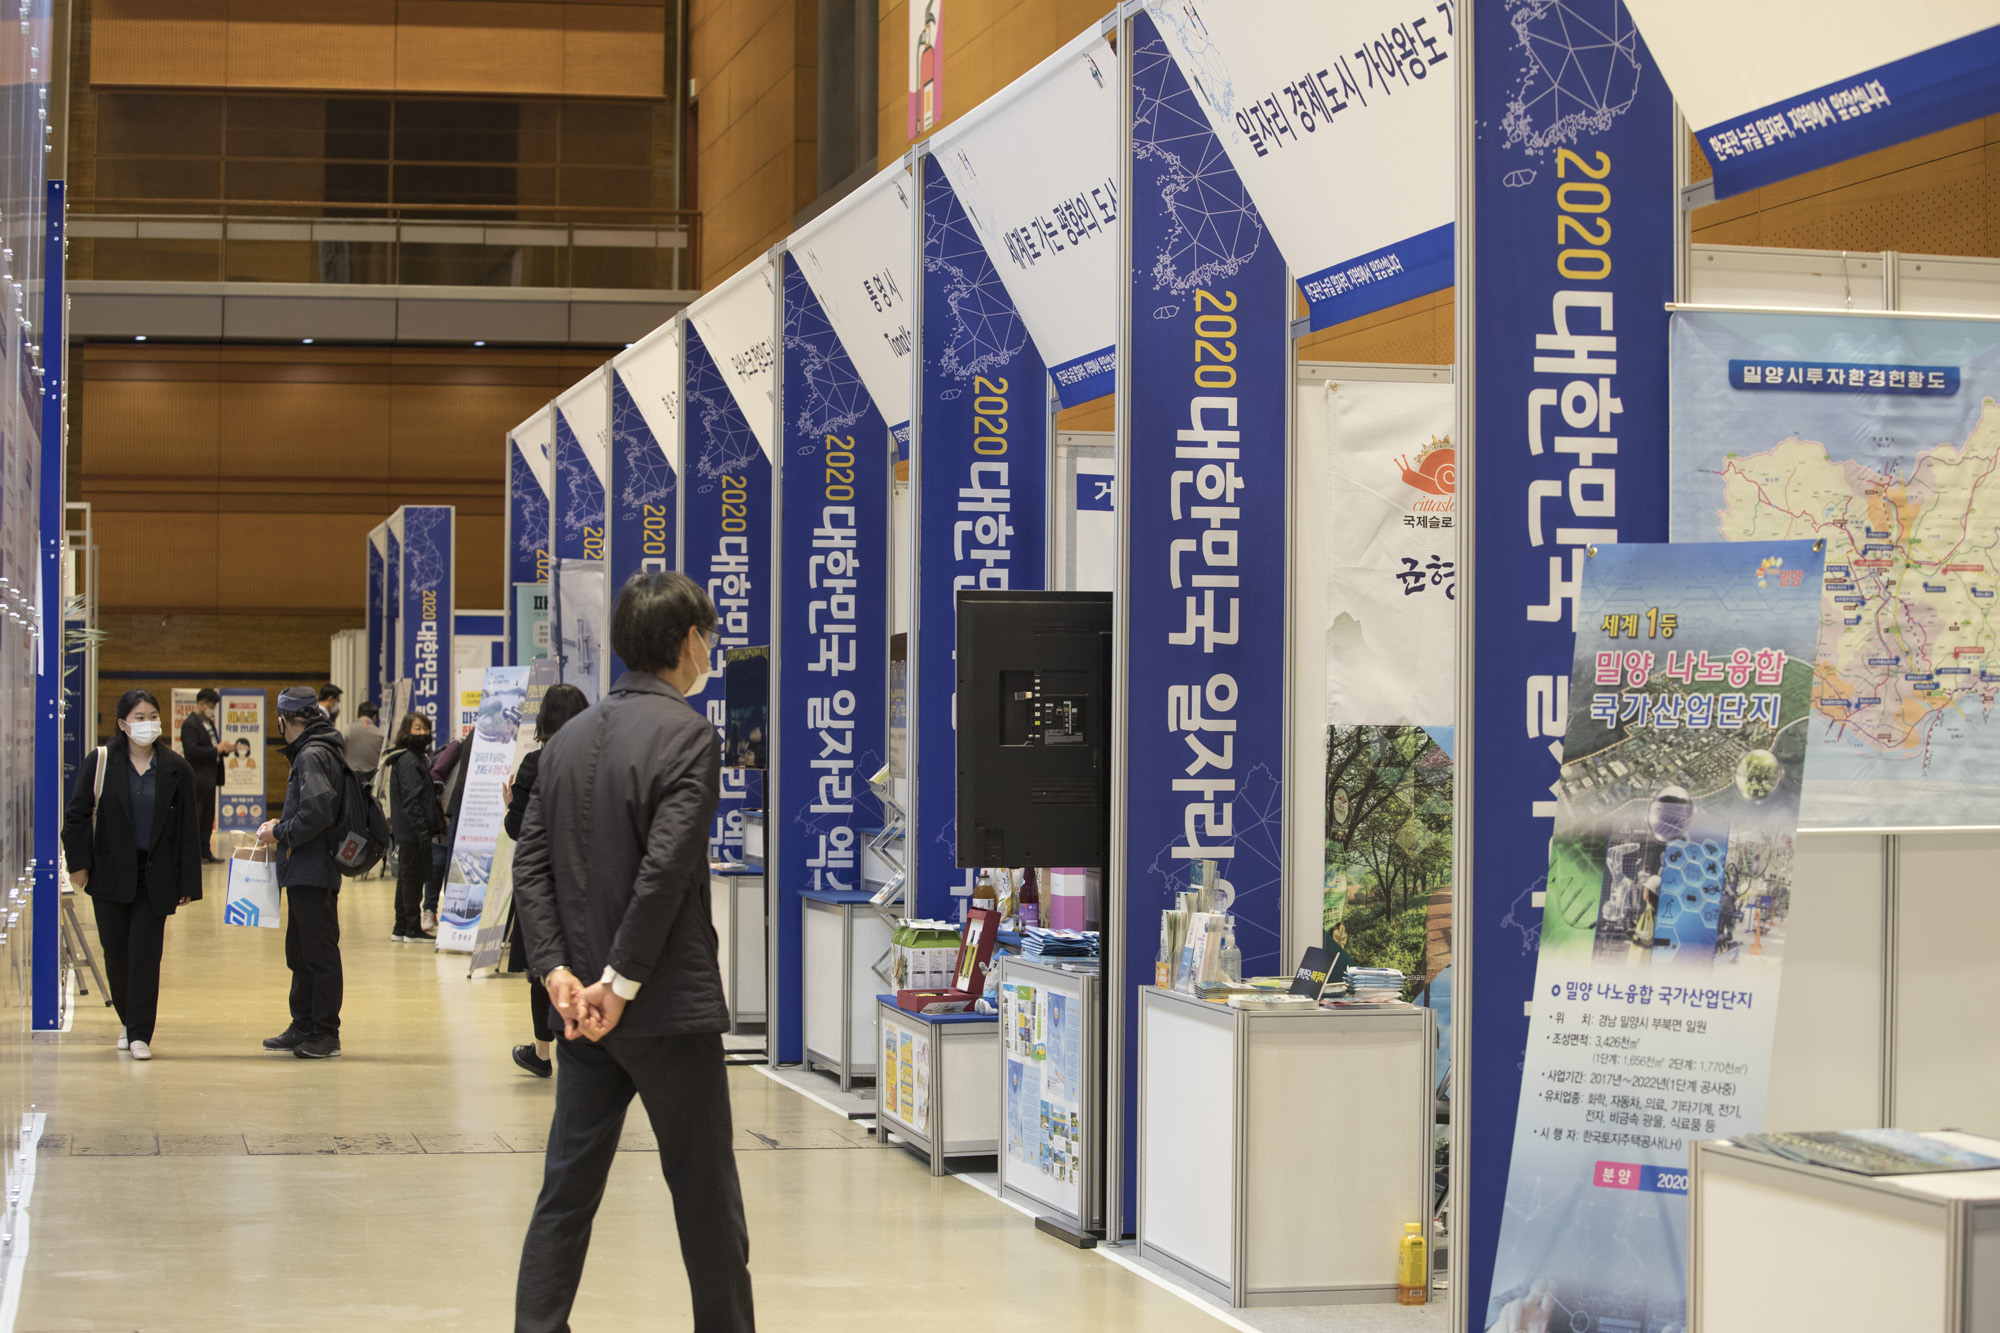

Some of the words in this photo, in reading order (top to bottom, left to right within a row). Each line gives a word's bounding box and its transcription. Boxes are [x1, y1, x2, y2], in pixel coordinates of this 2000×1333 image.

[1235, 92, 1298, 157] 일자리
[1282, 73, 1367, 133] 경제도시
[1354, 22, 1449, 96] 가야왕도
[1708, 130, 1745, 161] 한국판
[1736, 122, 1764, 152] 뉴딜
[1786, 97, 1838, 134] 지역에서
[1002, 227, 1041, 270] 세계로
[1030, 216, 1065, 256] 가는
[1052, 192, 1102, 246] 평화의
[1557, 148, 1612, 280] 2020
[863, 267, 904, 313] 통영시
[1194, 289, 1238, 389] 2020
[1743, 366, 1946, 389] 밀양시투자환경현황도
[973, 376, 1009, 456] 2020
[826, 434, 856, 501] 2020
[643, 504, 666, 555] 2020
[721, 475, 747, 532] 2020
[1168, 396, 1246, 653] 대한민국
[1402, 515, 1455, 529] 국제슬로
[422, 590, 436, 621] 2020
[807, 505, 861, 677] 대한민국
[1779, 569, 1804, 588] 밀양
[1601, 613, 1640, 639] 세계
[1646, 607, 1678, 639] 1등
[415, 620, 440, 698] 대한민국
[1595, 650, 1655, 686] 밀양
[1666, 648, 1788, 687] 나노융합
[1591, 693, 1781, 729] 국가산업단지
[807, 689, 857, 814] 일자리
[1167, 673, 1239, 859] 일자리
[1555, 1011, 1565, 1025] 위
[1598, 1014, 1617, 1029] 경남
[1620, 1015, 1649, 1030] 밀양시
[1651, 1017, 1682, 1033] 부북면
[1686, 1020, 1707, 1034] 일원
[1566, 981, 1593, 1001] 밀양
[1596, 983, 1654, 1005] 나노융합
[1658, 986, 1753, 1010] 국가산업단지
[1700, 1079, 1737, 1097] 공사중)
[1670, 1117, 1701, 1132] 식료품
[1704, 1119, 1716, 1134] 등
